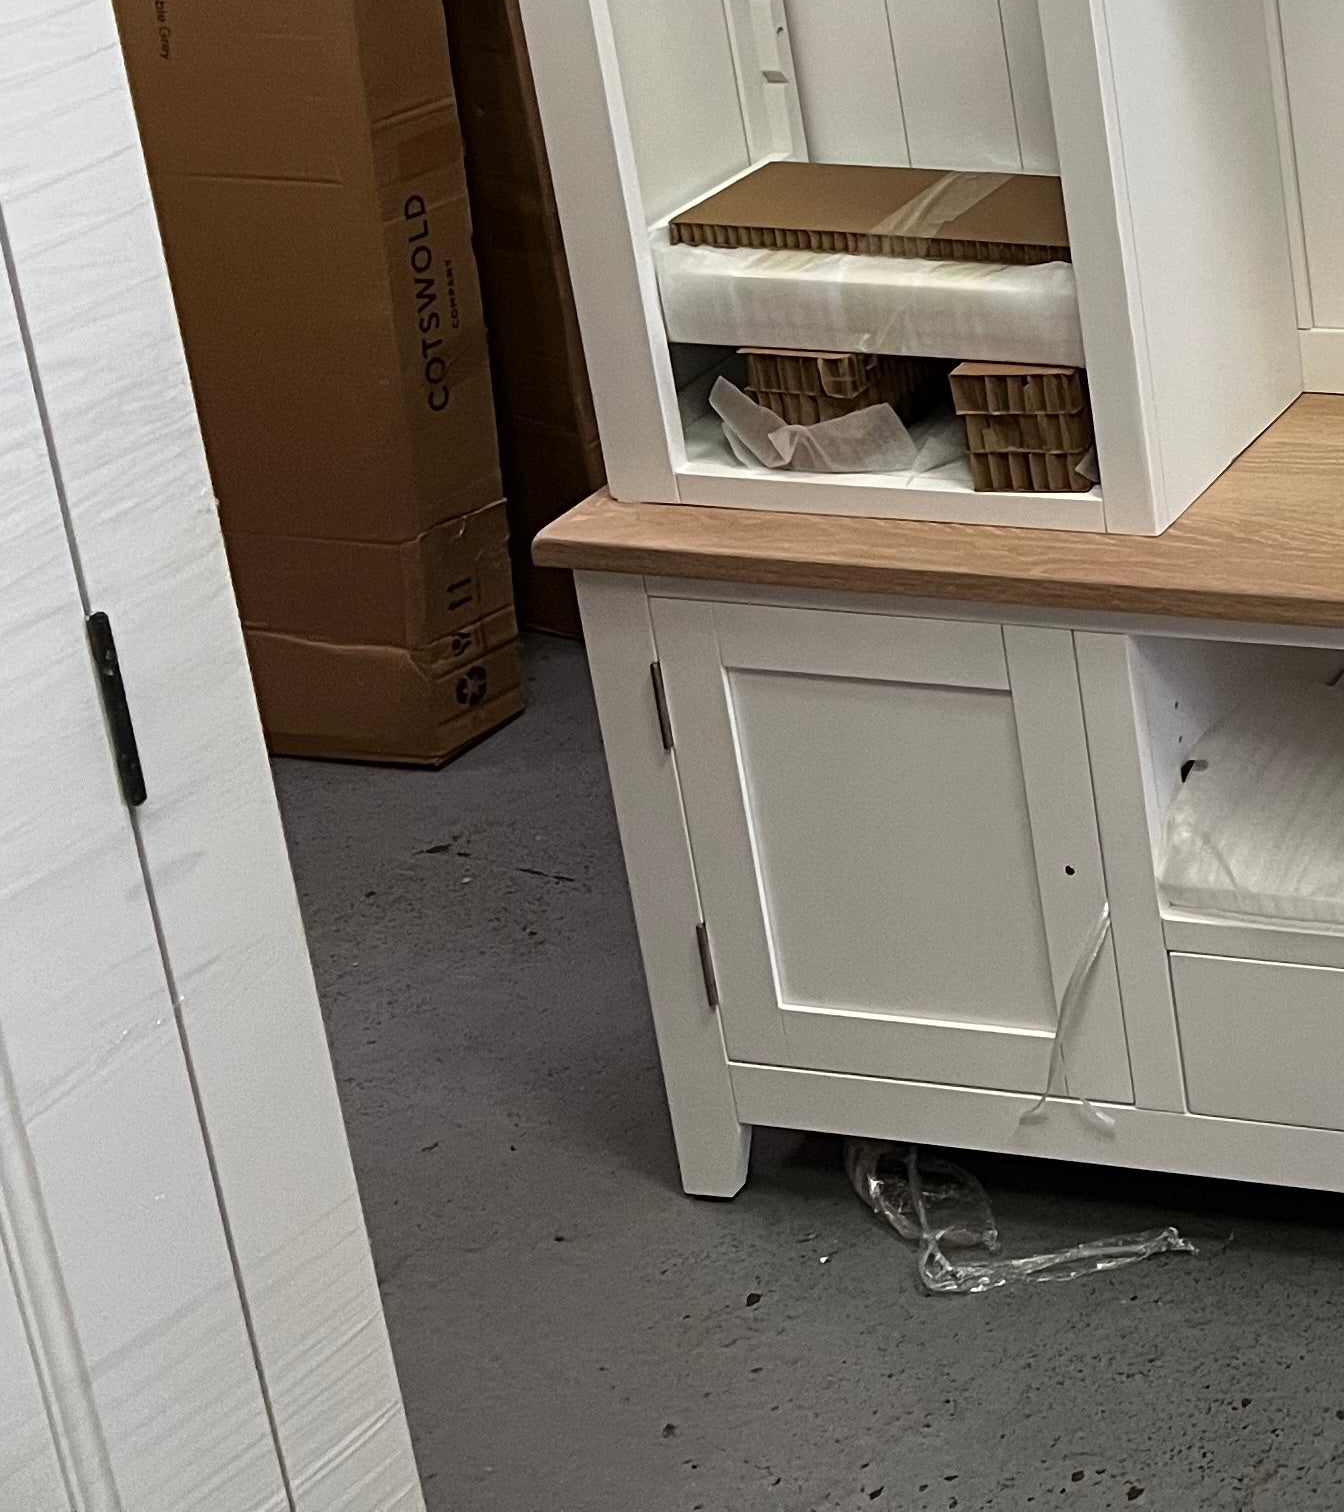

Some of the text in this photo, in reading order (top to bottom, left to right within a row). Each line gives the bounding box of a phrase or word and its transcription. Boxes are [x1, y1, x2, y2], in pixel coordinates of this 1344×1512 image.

[154, 24, 174, 61] Grey
[403, 195, 449, 413] COTSWOLD
[443, 258, 460, 329] COMPANY
